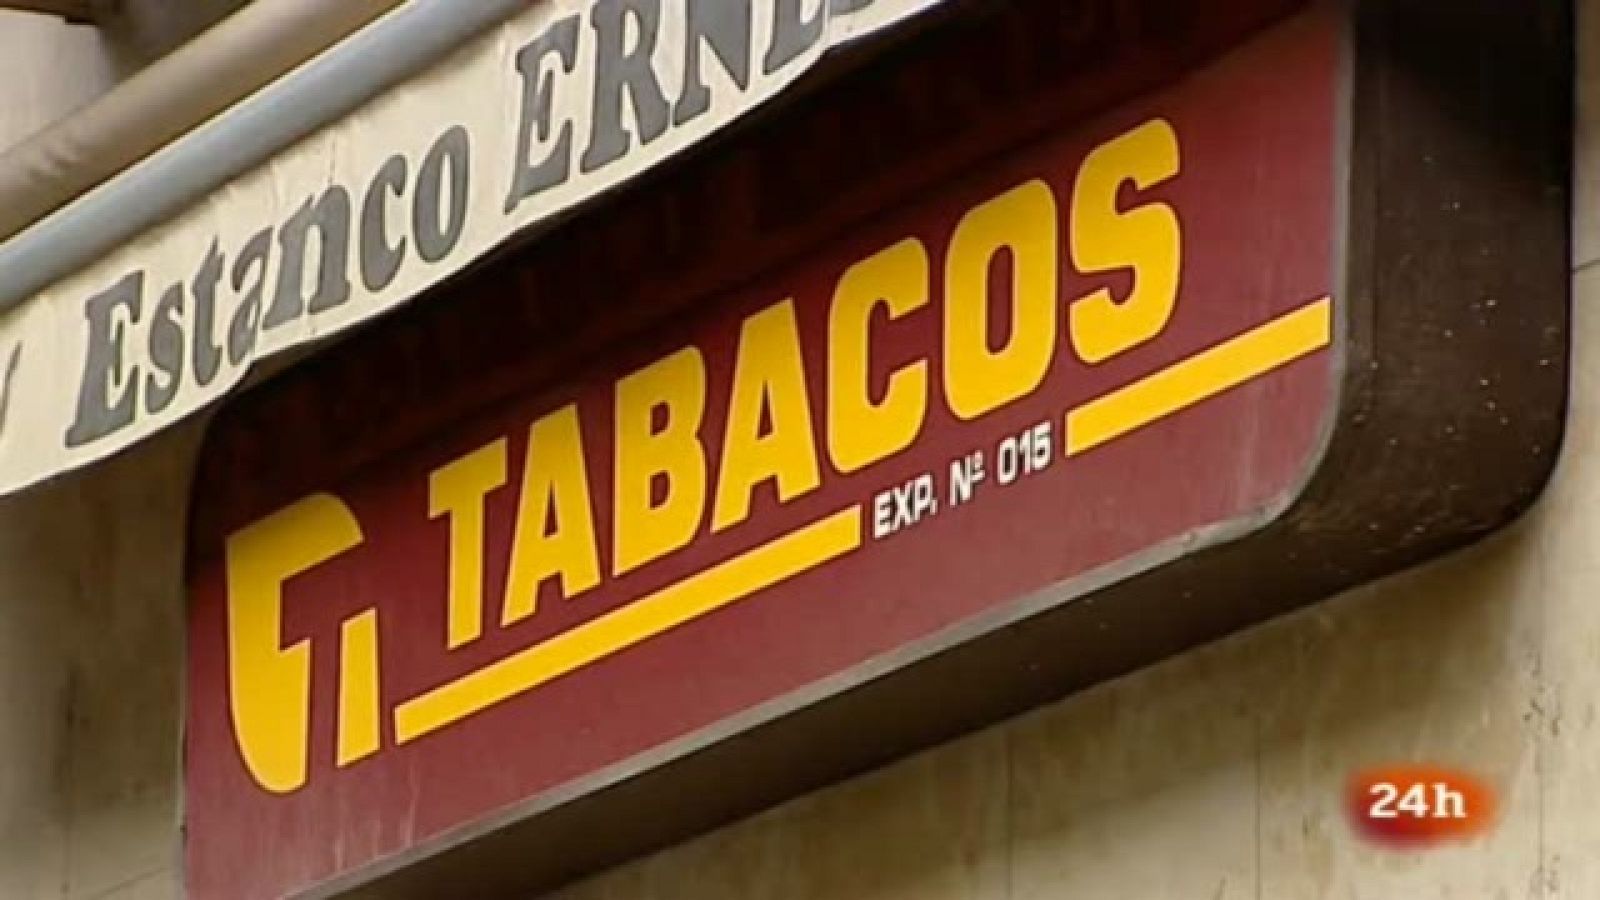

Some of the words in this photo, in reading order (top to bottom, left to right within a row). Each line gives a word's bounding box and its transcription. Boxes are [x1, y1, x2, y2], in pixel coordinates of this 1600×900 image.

[64, 125, 470, 447] Estanco
[429, 118, 1181, 650] TABACOS
[873, 473, 938, 539] EXP.
[997, 420, 1051, 485] 015
